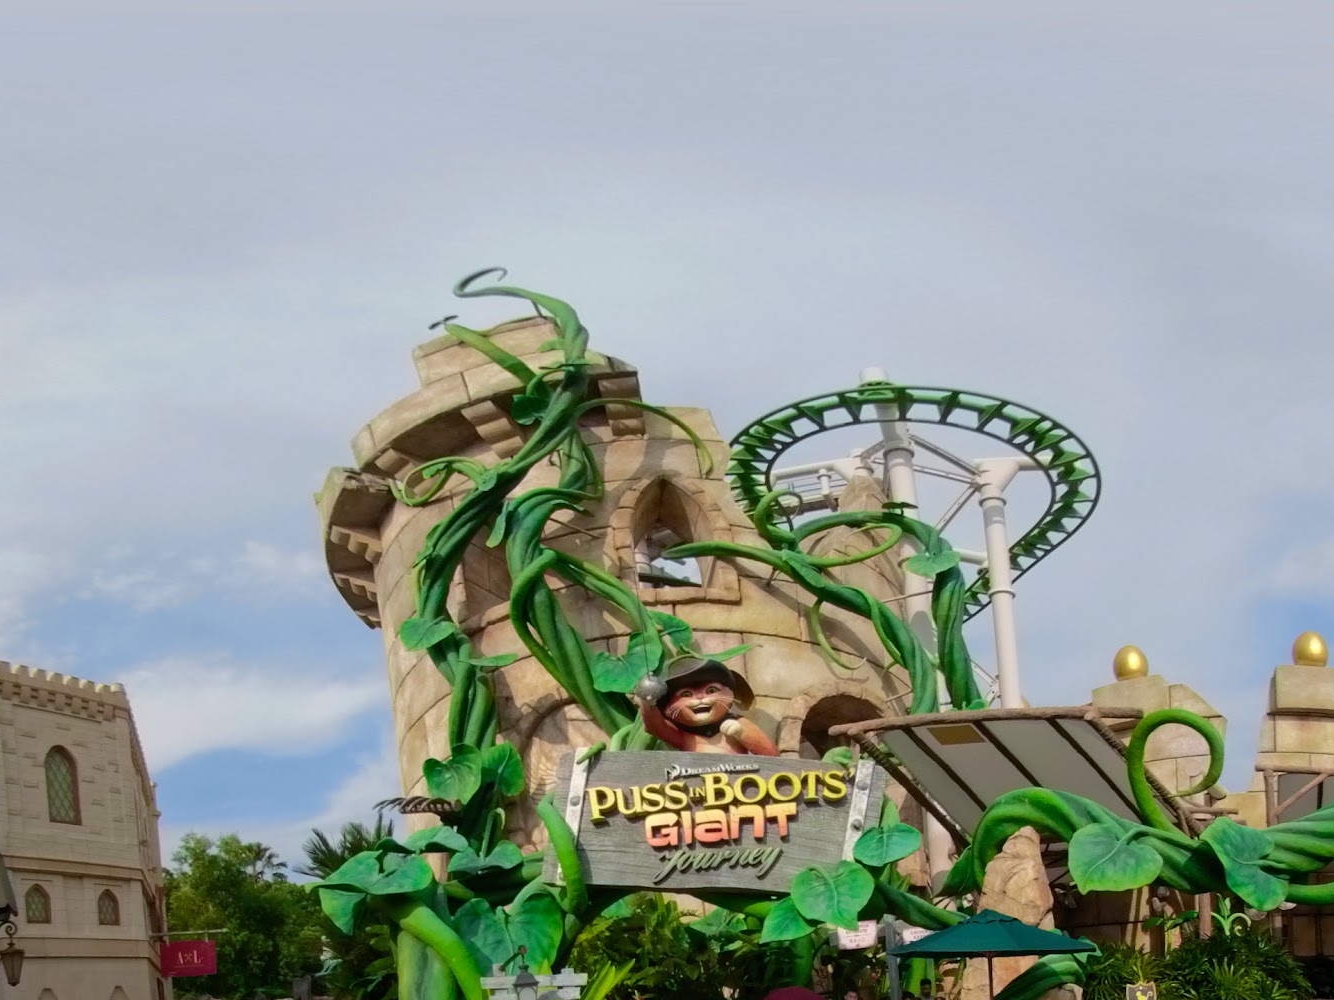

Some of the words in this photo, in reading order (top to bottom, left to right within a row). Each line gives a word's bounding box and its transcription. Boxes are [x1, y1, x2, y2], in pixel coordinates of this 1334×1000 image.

[586, 781, 689, 823] PUSS
[689, 786, 706, 800] IN
[644, 802, 797, 848] GIANT
[651, 845, 783, 885] Journey
